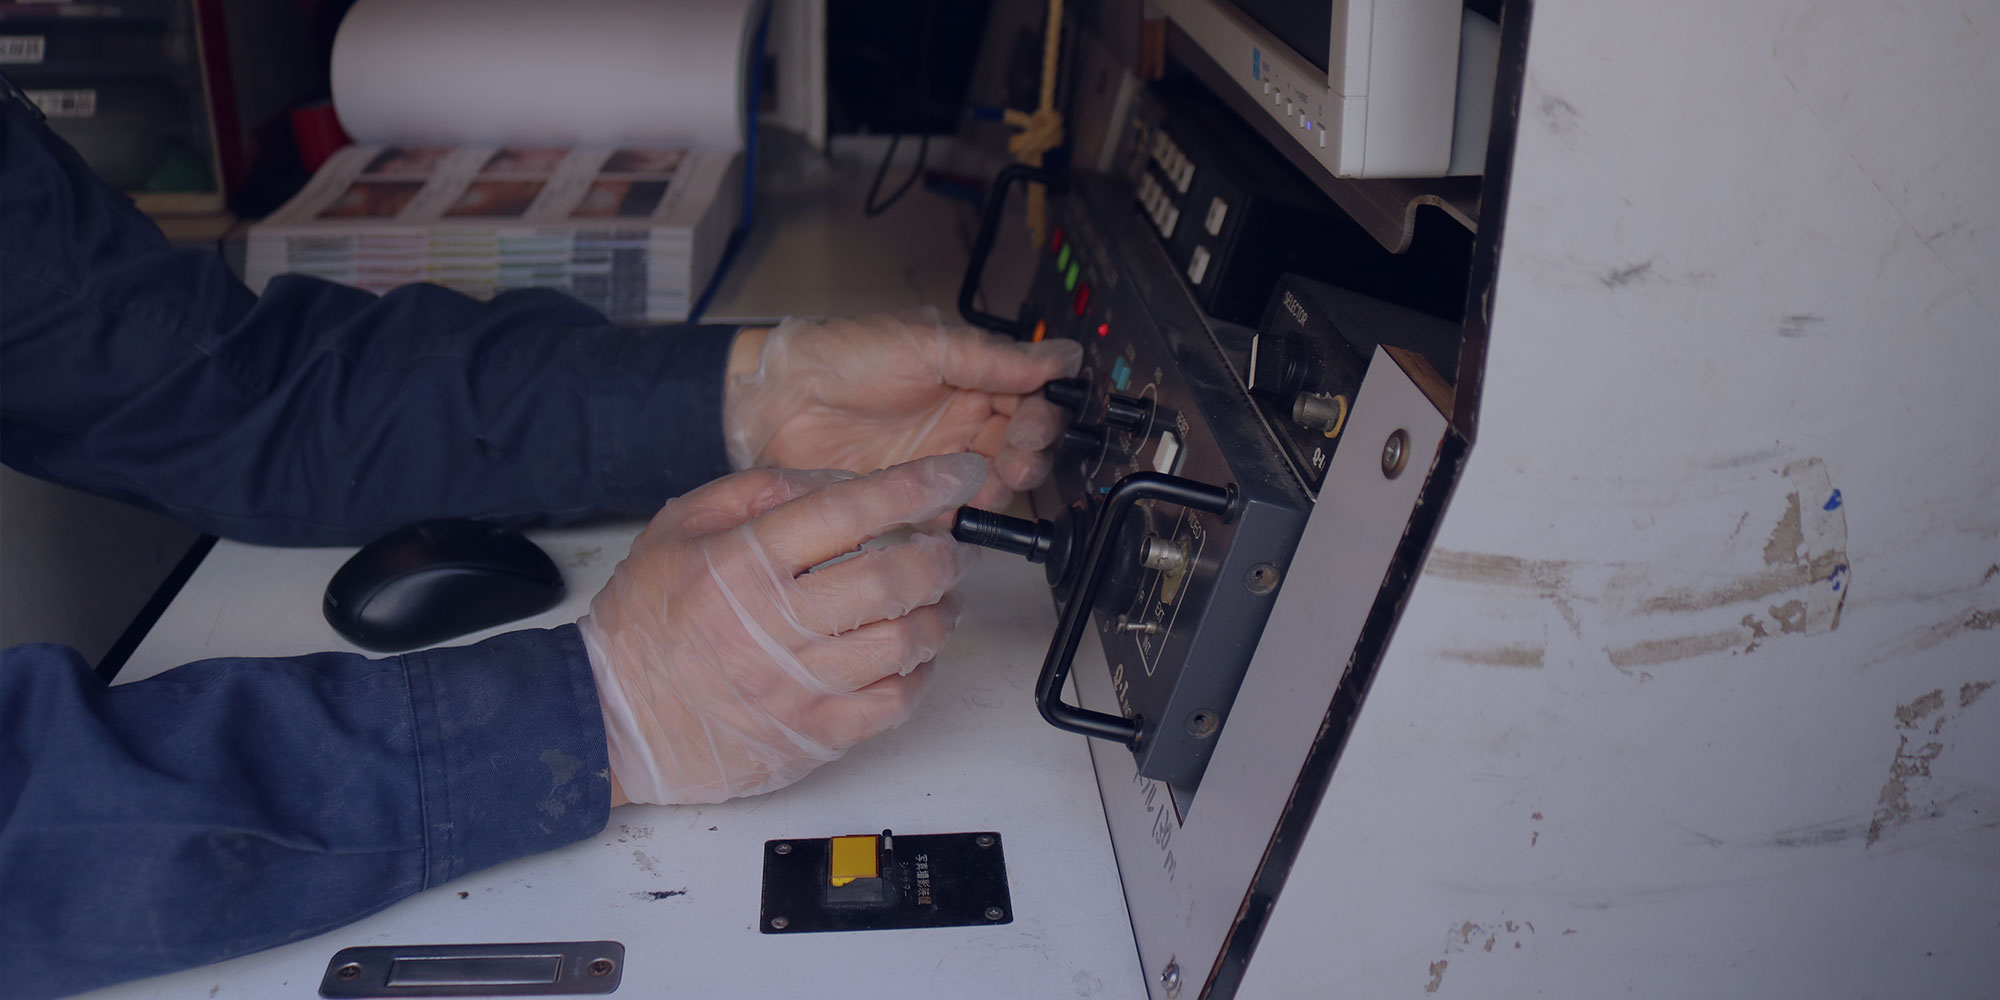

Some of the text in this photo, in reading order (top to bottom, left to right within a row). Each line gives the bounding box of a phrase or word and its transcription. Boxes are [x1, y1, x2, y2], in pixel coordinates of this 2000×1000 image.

[1284, 291, 1308, 327] SELECTOR
[1176, 410, 1190, 439] RESET
[1188, 508, 1201, 539] VIDEO
[915, 854, 931, 905] 写真撮影装置
